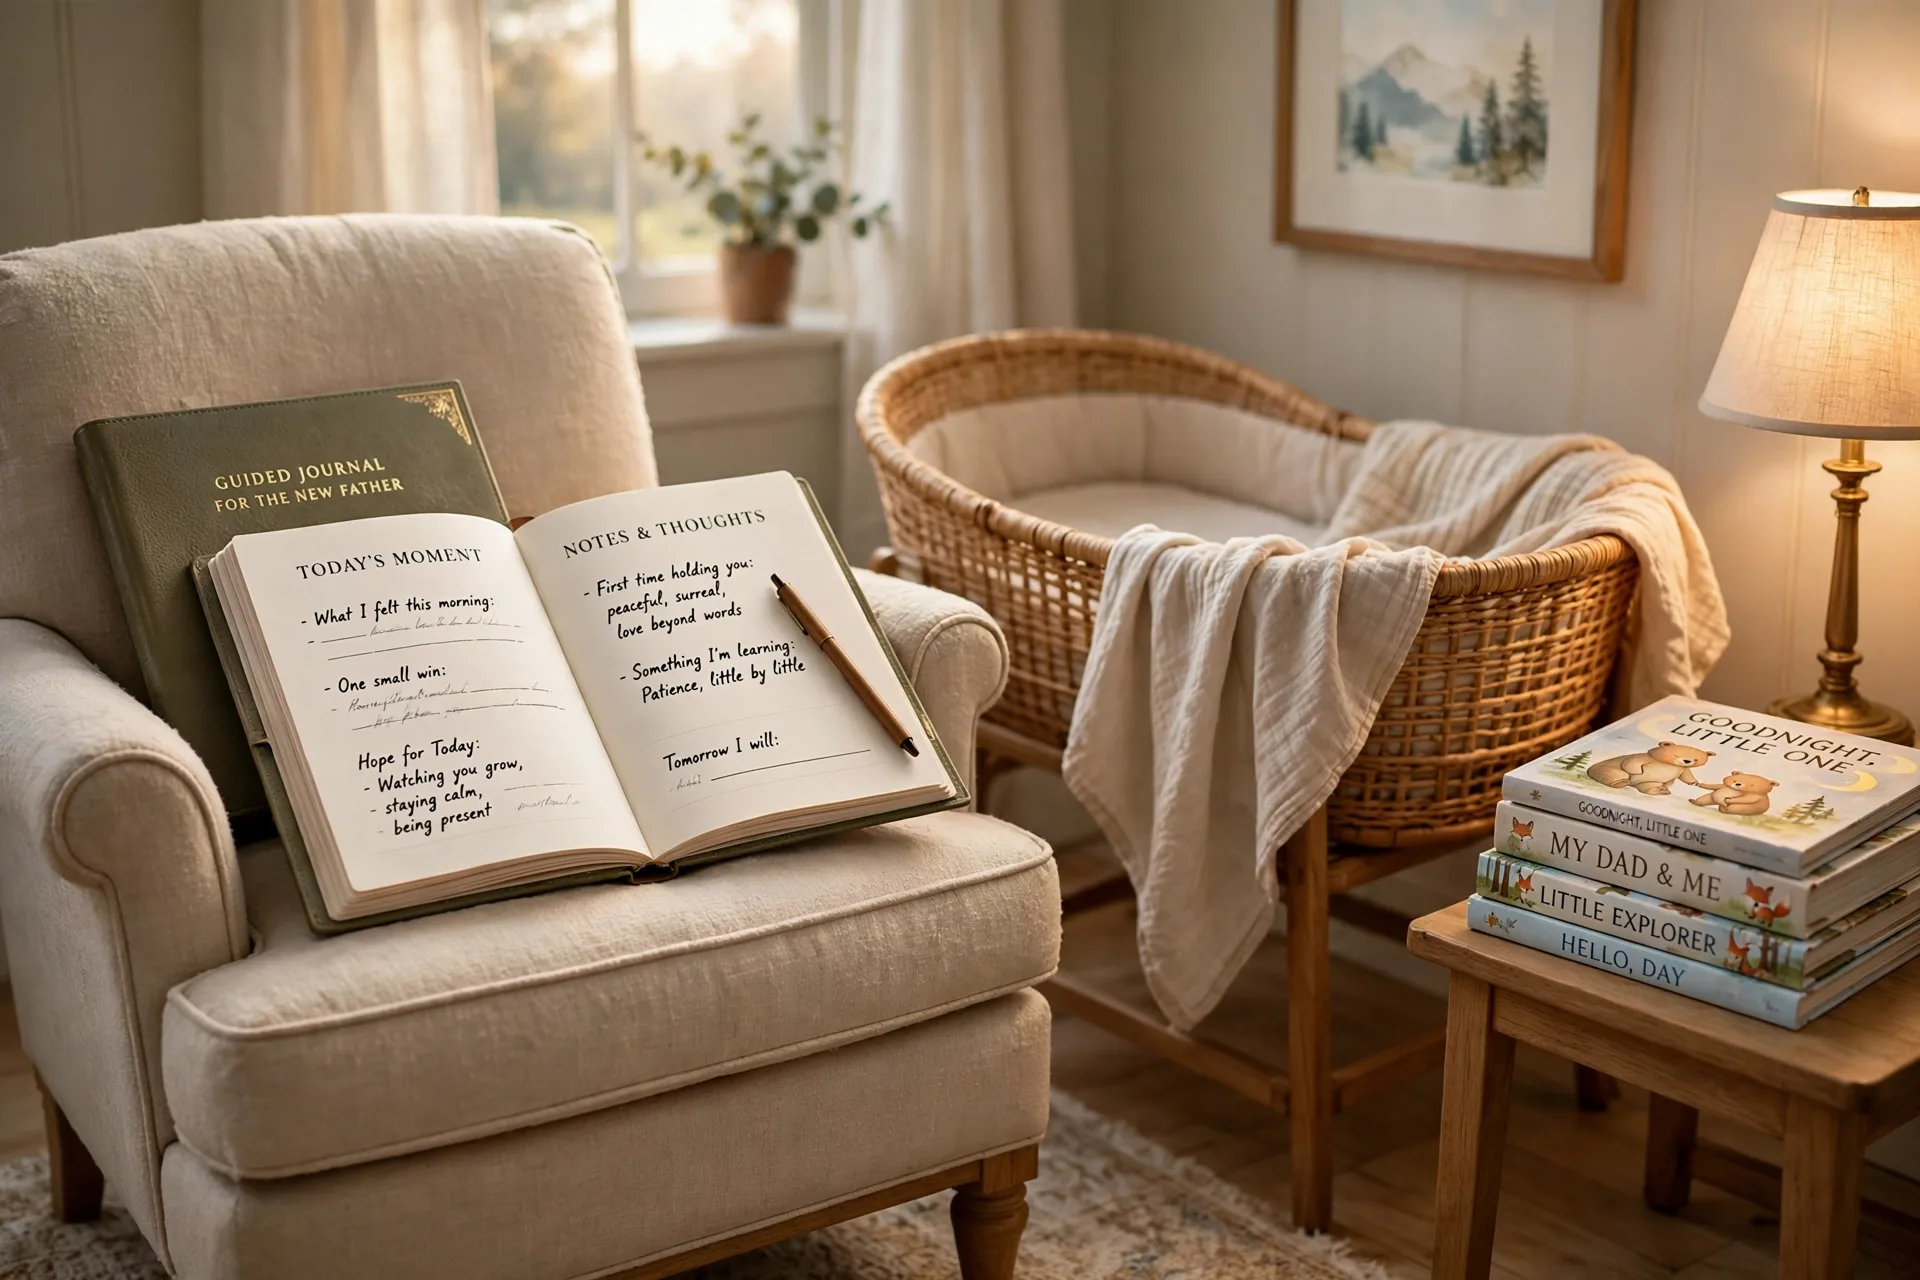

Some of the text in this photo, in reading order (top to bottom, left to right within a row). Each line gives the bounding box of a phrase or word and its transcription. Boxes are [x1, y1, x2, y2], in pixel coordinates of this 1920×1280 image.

[214, 457, 386, 490] GUIDED JOURNAL
[214, 478, 404, 513] FOR THE NEW FATHER
[562, 509, 766, 559] NOTES & THOUGHTS
[295, 548, 482, 580] TODAY'S MOMENT
[596, 560, 753, 597] First time holding you:
[314, 607, 353, 626] What
[360, 603, 367, 619] I
[373, 599, 400, 623] felt
[405, 597, 432, 612] this
[438, 596, 495, 612] morning:
[607, 580, 726, 624] peaceful, surreal,
[617, 601, 742, 640] love beyond words
[338, 666, 446, 694] One small win:
[632, 641, 795, 681] Something I'm learning:
[641, 657, 806, 704] Patience, little by little
[358, 737, 480, 774] Hope for Today:
[662, 731, 781, 772] Tomorrow I will:
[1670, 723, 1855, 775] LITTLE ONE
[1688, 711, 1881, 766] GOODNIGHT,
[378, 761, 523, 793] Watching you grow,
[385, 784, 483, 817] staying calm,
[394, 820, 432, 837] being
[441, 802, 492, 831] present
[1578, 801, 1707, 846] GOODNIGHT, LITTLE ONE
[1549, 832, 1721, 902] MY DAD & ME
[1541, 885, 1717, 955] LITTLE EXPLORER
[1561, 932, 1686, 987] HELLO, DAY
